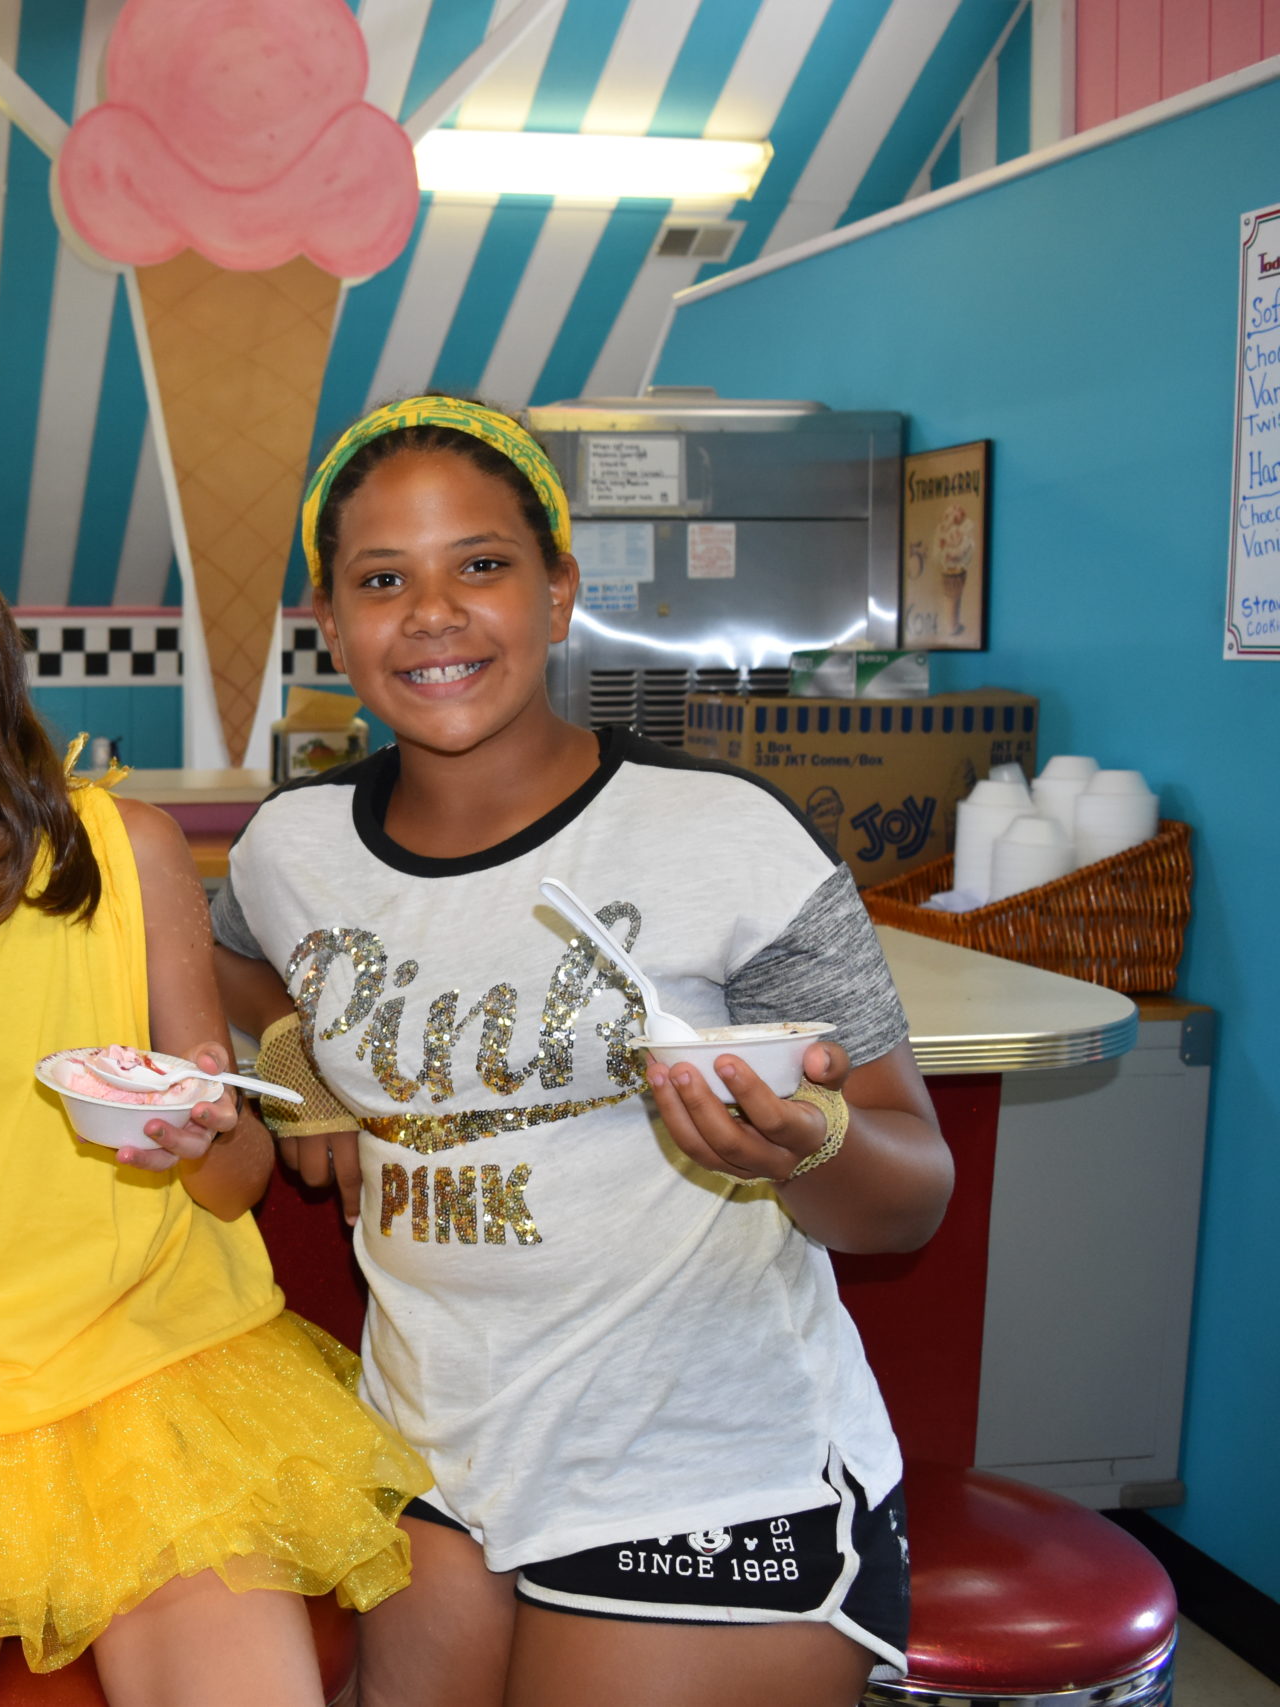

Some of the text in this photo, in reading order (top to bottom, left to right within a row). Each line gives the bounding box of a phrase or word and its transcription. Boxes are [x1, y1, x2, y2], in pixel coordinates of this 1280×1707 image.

[755, 741, 763, 753] 1
[768, 741, 792, 753] Box
[755, 754, 780, 767] 338
[784, 754, 807, 767] JKT
[380, 1163, 542, 1245] PINK
[619, 1551, 799, 1582] SINCE 1928
